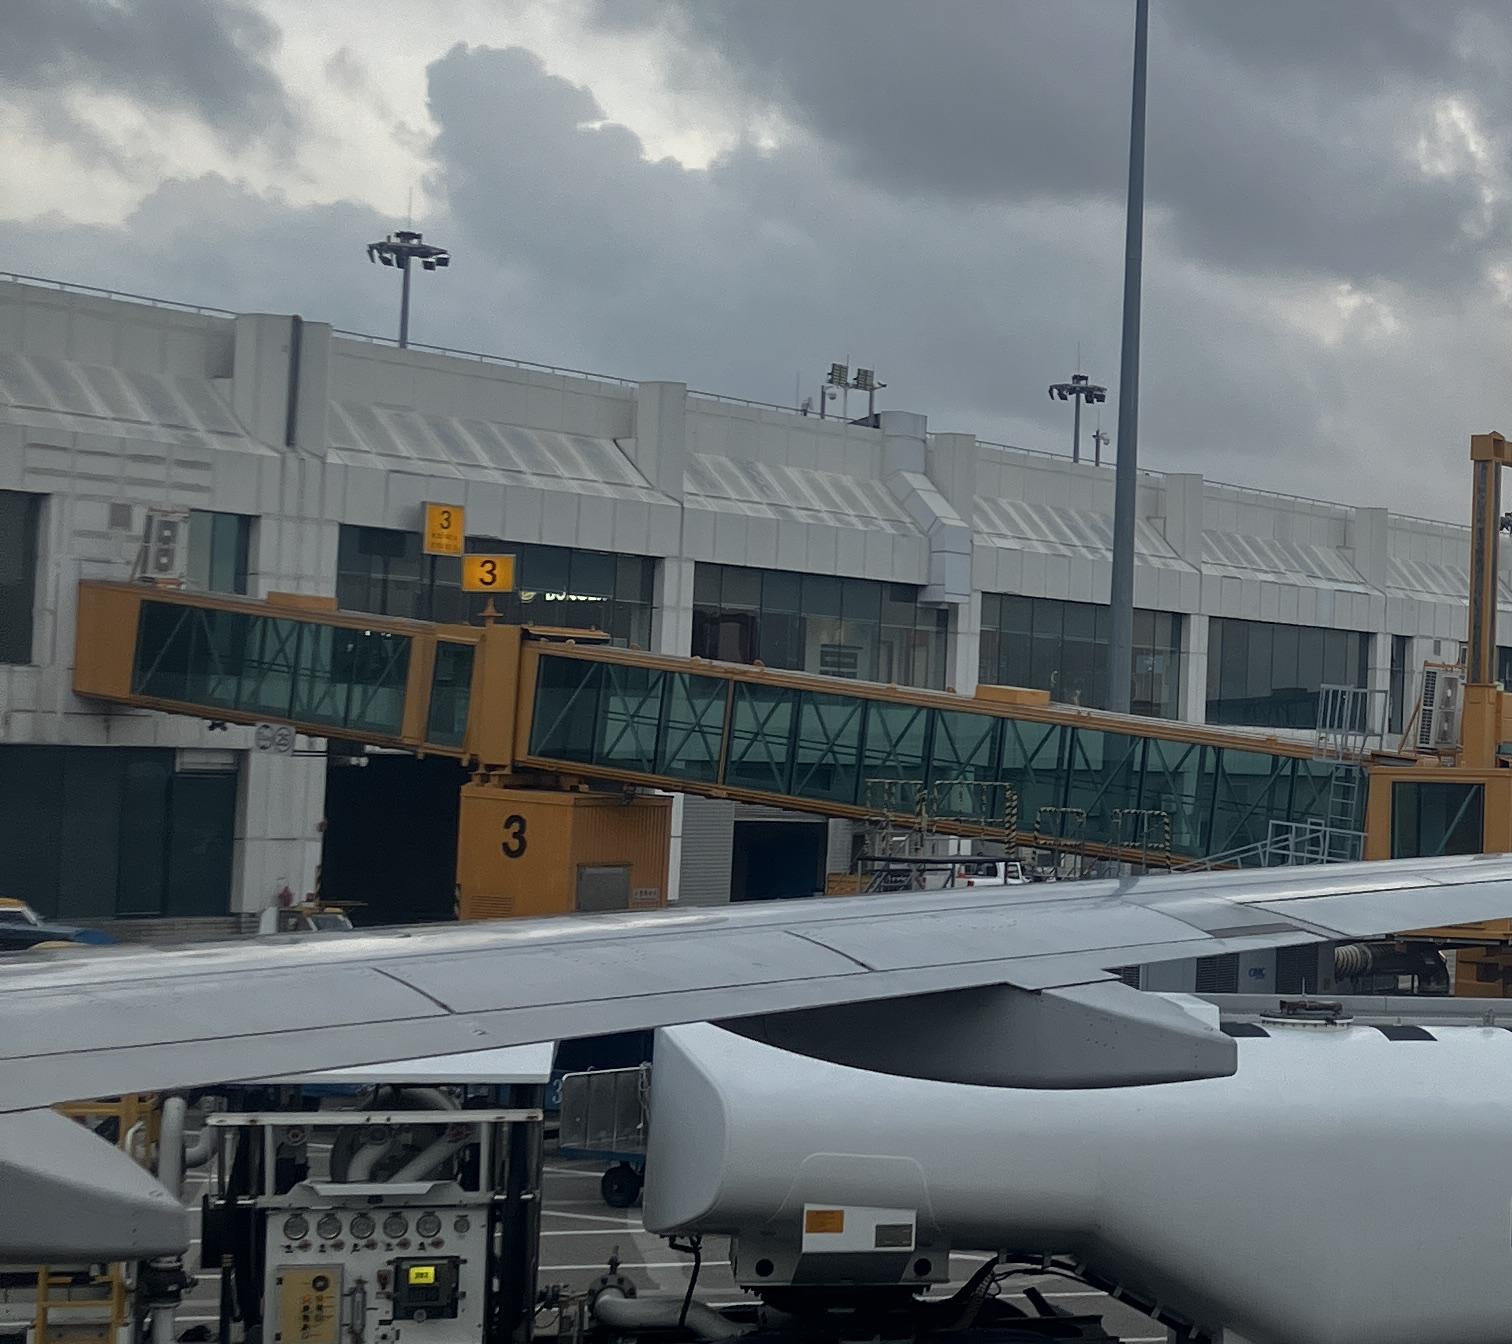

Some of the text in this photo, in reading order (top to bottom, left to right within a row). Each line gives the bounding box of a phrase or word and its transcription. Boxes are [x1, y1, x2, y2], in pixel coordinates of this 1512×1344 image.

[439, 510, 452, 530] 3
[479, 559, 497, 586] 3
[502, 814, 528, 859] 3
